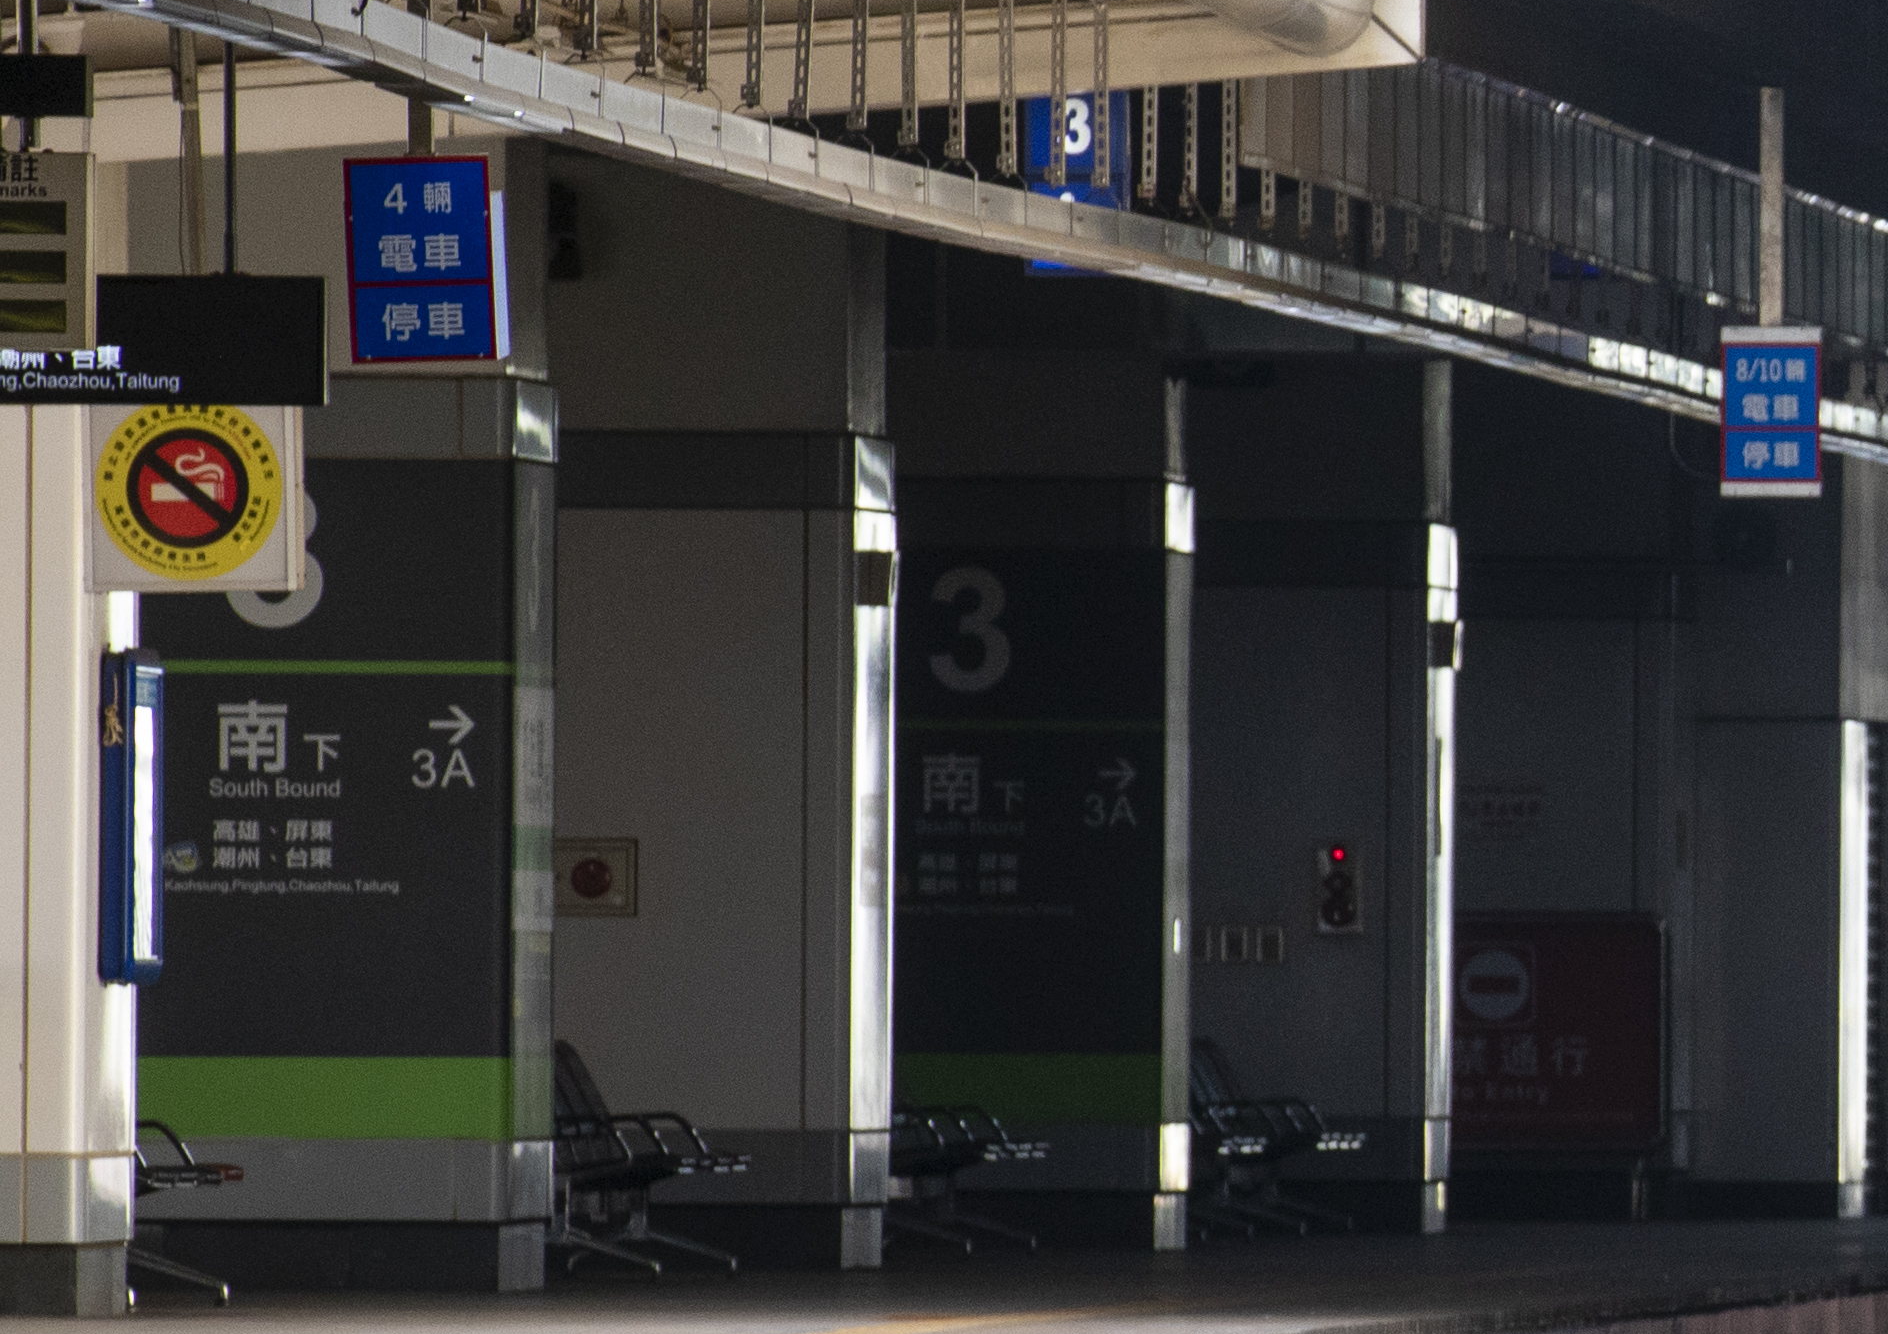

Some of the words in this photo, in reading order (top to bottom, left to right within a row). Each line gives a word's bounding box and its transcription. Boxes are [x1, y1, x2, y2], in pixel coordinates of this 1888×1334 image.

[1056, 97, 1092, 155] 3
[384, 182, 408, 214] 4
[378, 233, 461, 273] 電車
[382, 301, 466, 341] 停車
[930, 567, 1011, 693] 3
[209, 778, 268, 798] South
[275, 779, 341, 798] Bound
[411, 748, 476, 789] 3A
[1083, 794, 1136, 827] 3A
